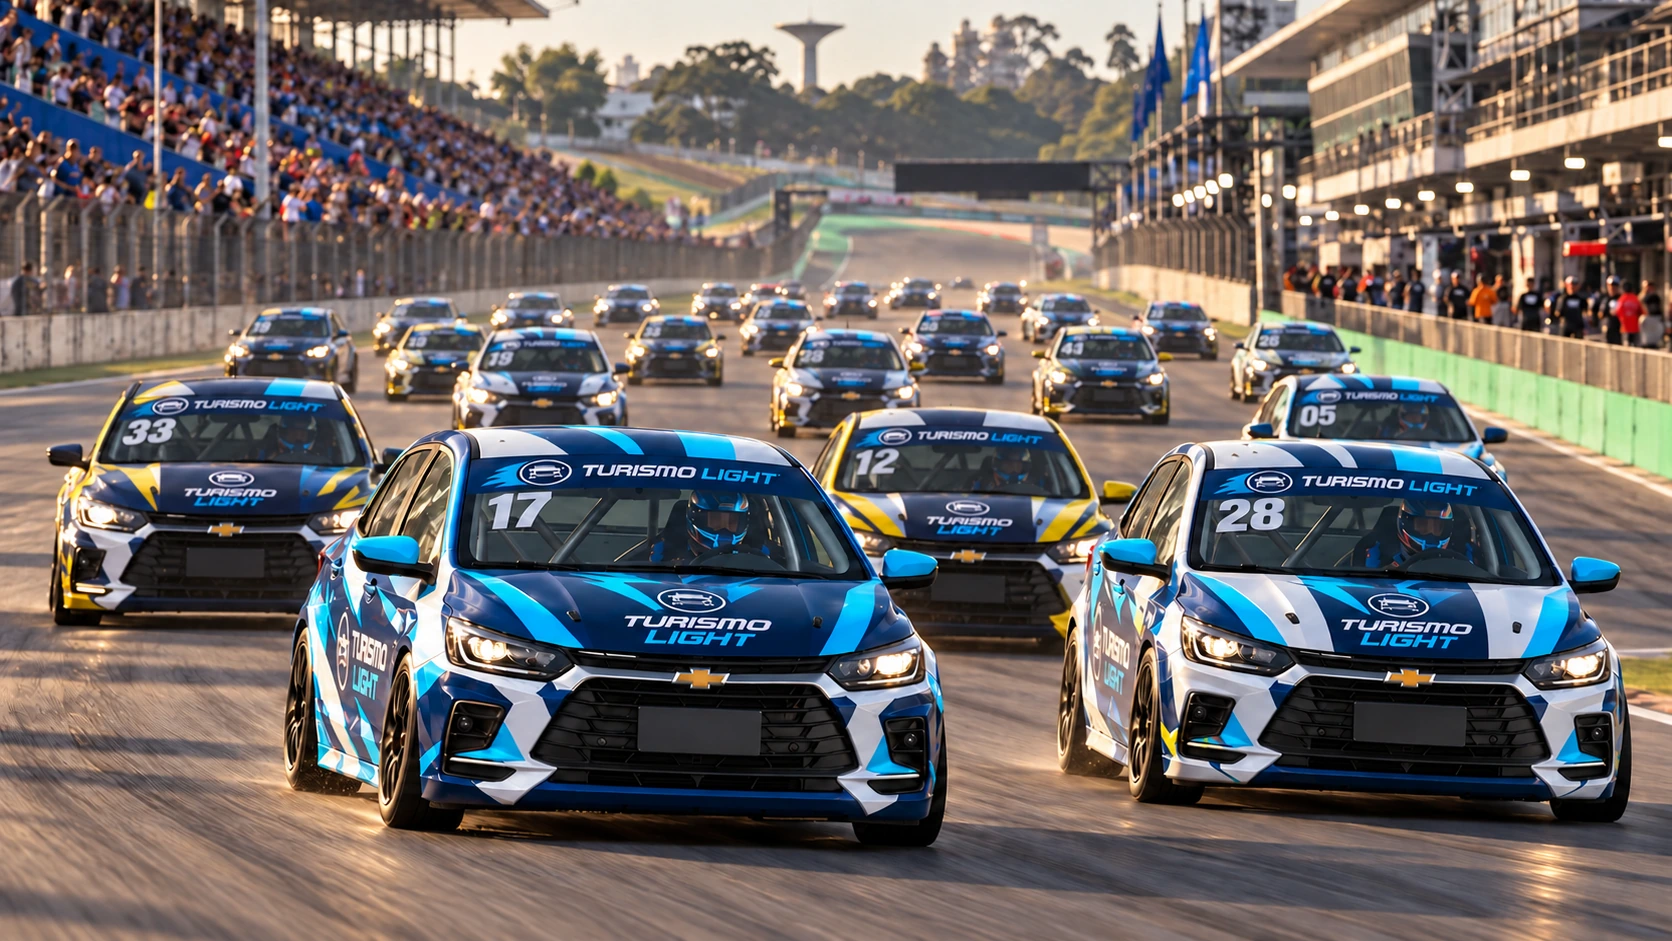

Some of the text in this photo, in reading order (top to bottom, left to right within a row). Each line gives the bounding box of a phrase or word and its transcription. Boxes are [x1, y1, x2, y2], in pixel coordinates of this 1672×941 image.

[1258, 335, 1280, 348] 26
[488, 351, 515, 367] 19
[194, 399, 323, 412] TURISMO LIGHT
[1344, 391, 1440, 403] TURISMO LIGHT
[1300, 404, 1337, 427] 05
[122, 417, 177, 446] 33
[918, 430, 1043, 445] TURISMO LIGHT
[856, 448, 900, 475] 12
[582, 464, 777, 485] TURISMO LIGHT
[184, 487, 278, 498] TURISMO
[1301, 475, 1478, 497] TURISMO LIGHT
[194, 496, 265, 507] LIGHT
[488, 491, 553, 530] 17
[1215, 497, 1286, 533] 28
[926, 515, 1014, 527] TURISMO
[936, 525, 1003, 536] LIGHT
[624, 615, 772, 632] TURISMO
[1340, 618, 1473, 635] TURISMO
[644, 630, 756, 647] LIGHT
[1360, 633, 1459, 650] LIGHT
[351, 629, 388, 672] TURISMO
[352, 664, 379, 700] LIGHT
